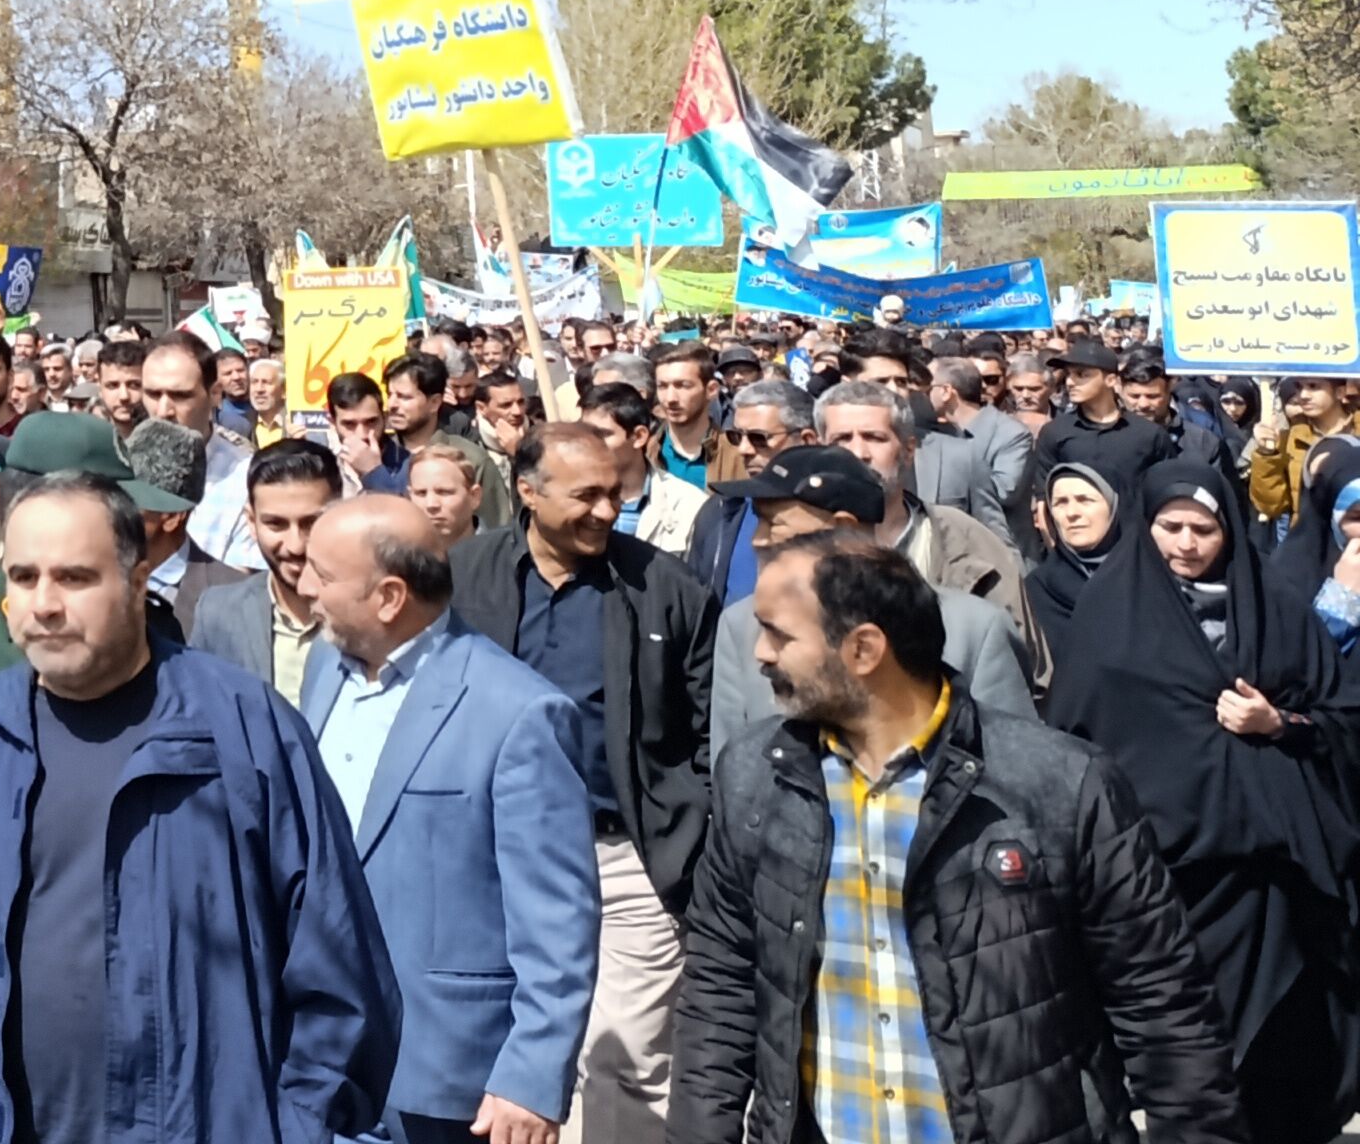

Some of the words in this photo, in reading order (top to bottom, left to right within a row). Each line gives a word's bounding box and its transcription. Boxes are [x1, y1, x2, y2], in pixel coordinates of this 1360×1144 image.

[453, 4, 528, 37] دانشگاه
[501, 72, 550, 102] واحد
[294, 275, 332, 288] Down
[334, 273, 364, 287] with
[367, 271, 396, 286] USA
[292, 307, 324, 326] بر
[327, 294, 388, 326] مرگ
[1272, 300, 1338, 322] شهدای
